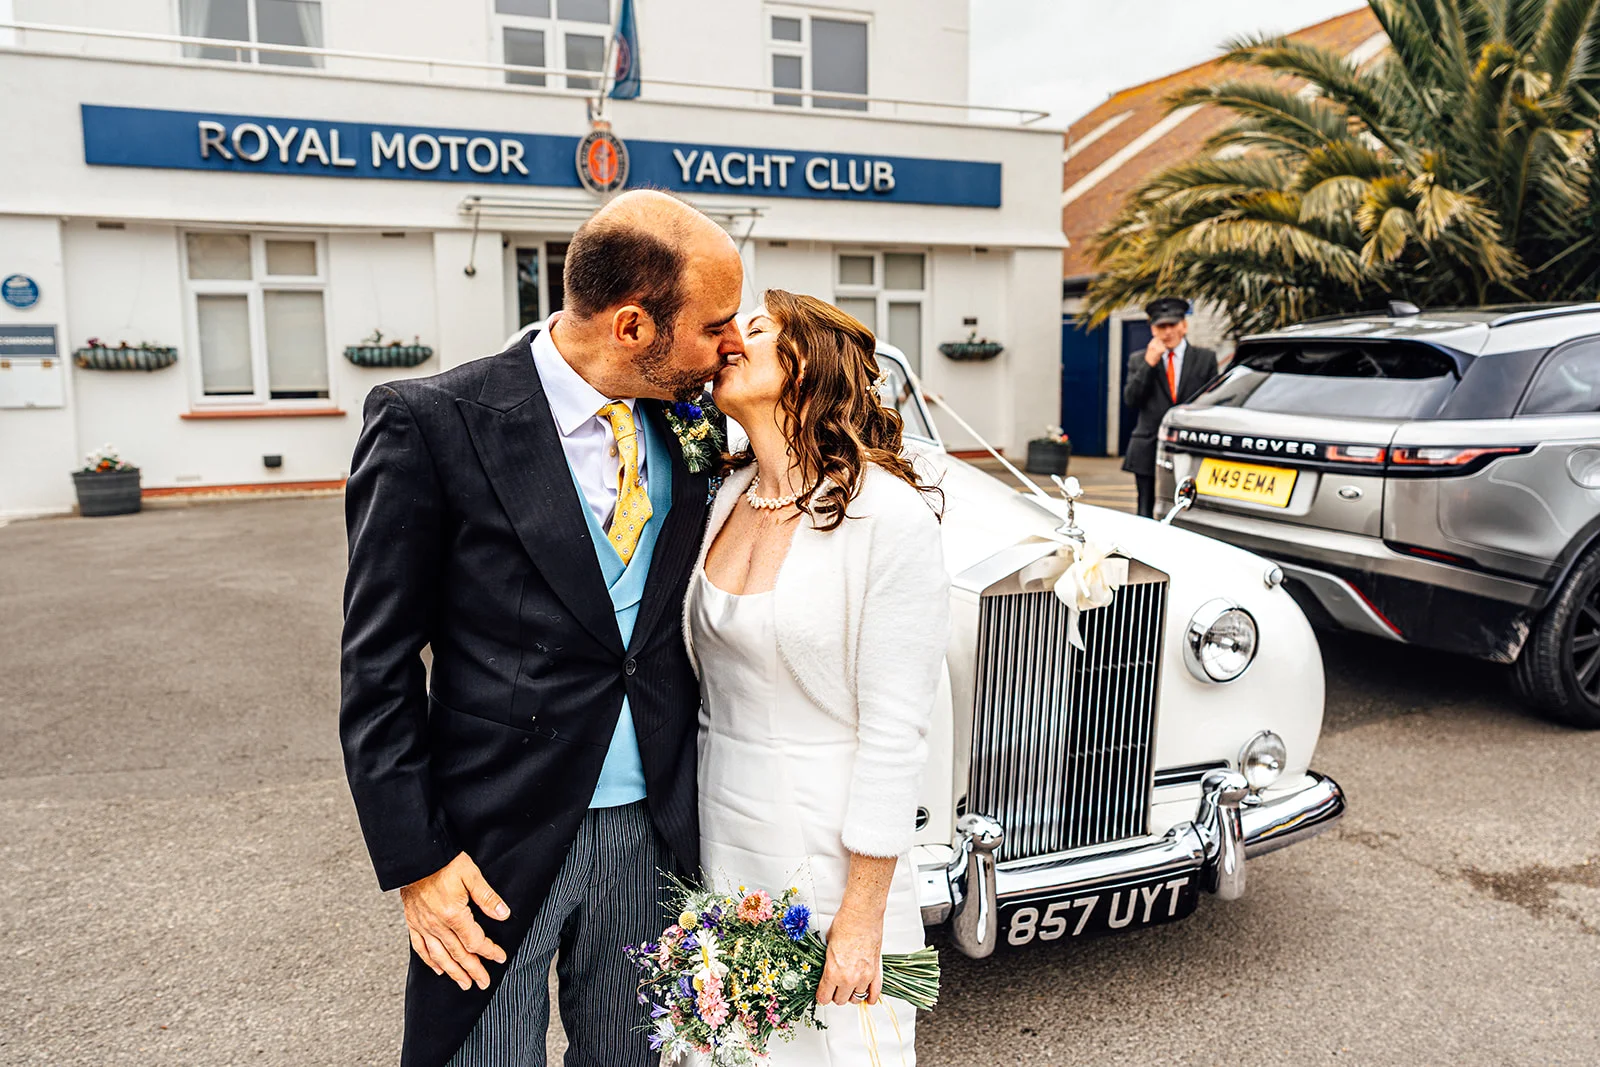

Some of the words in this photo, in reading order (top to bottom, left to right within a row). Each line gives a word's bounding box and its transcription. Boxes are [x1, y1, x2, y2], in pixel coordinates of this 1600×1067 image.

[198, 120, 357, 167] ROYAL
[371, 131, 529, 175] MOTOR
[673, 149, 796, 188] YACHT
[805, 157, 896, 193] CLUB
[1178, 430, 1233, 447] RANGE
[1241, 438, 1317, 455] ROVER
[1208, 468, 1241, 489] N49
[1242, 472, 1277, 496] EMA
[1007, 895, 1100, 946] 857
[1108, 877, 1190, 929] UYT
